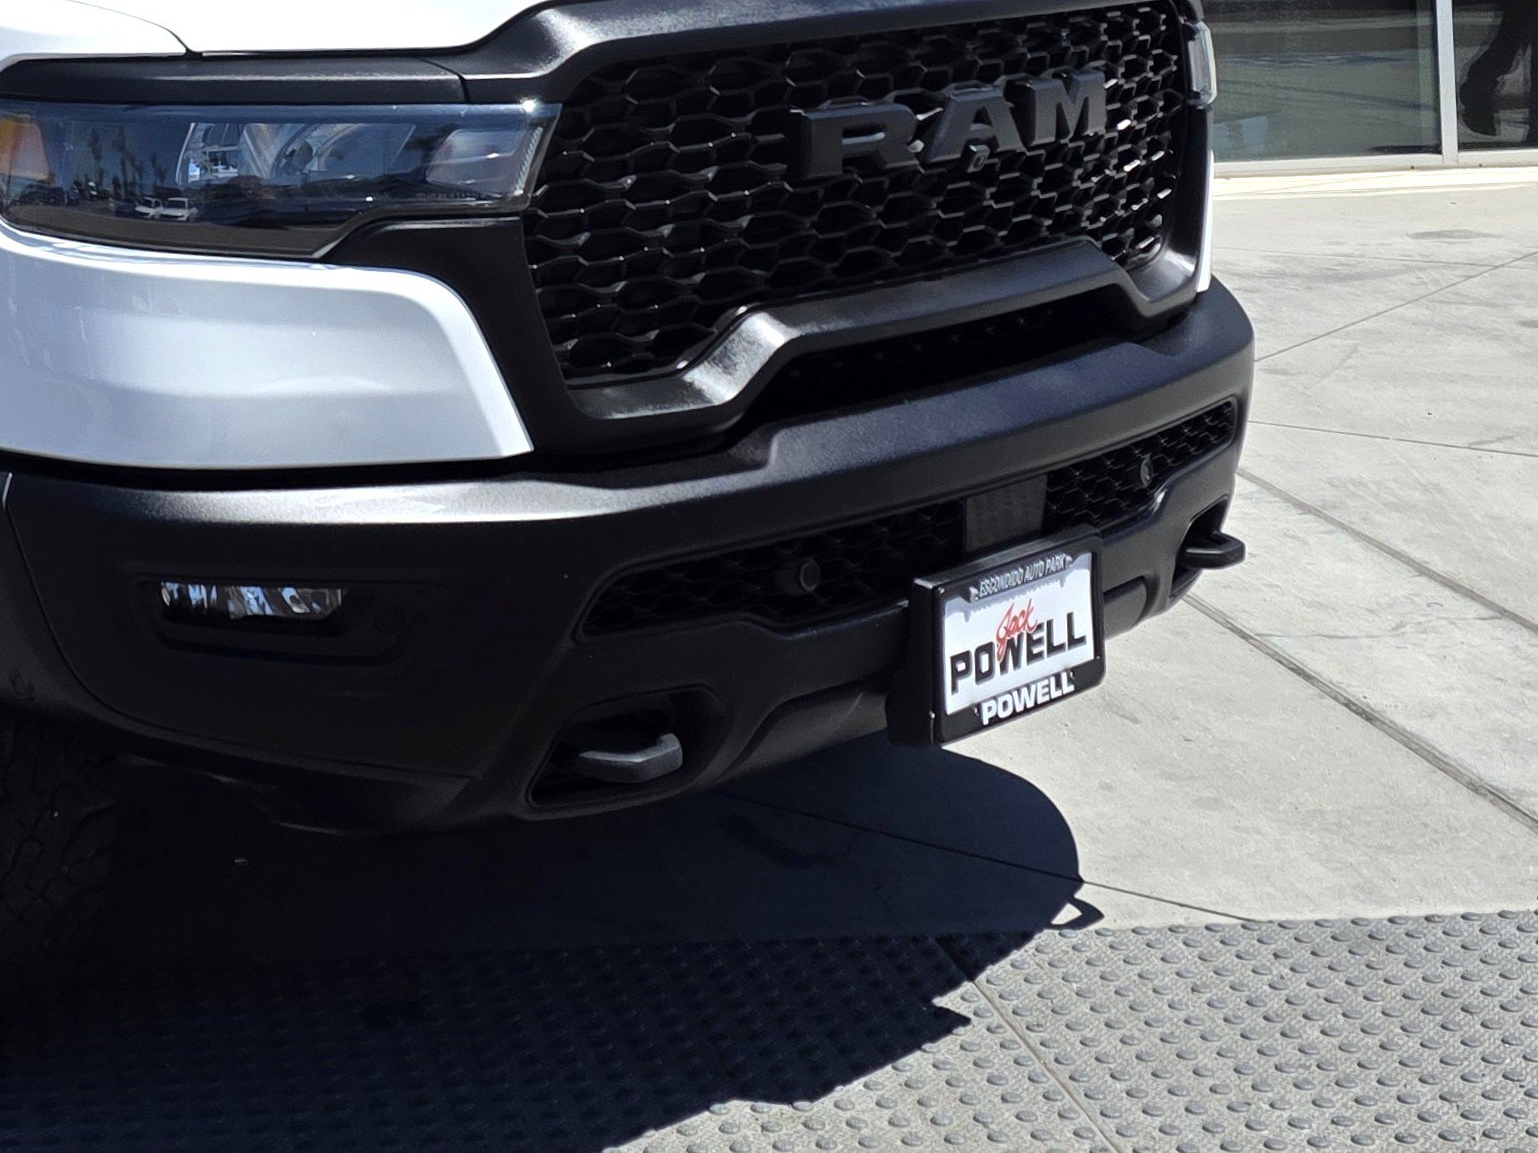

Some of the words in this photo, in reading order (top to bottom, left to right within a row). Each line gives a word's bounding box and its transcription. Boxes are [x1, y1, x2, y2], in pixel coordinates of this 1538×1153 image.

[802, 68, 1108, 178] RAM
[1024, 560, 1045, 583] AUTO
[1044, 552, 1067, 576] PARK
[949, 611, 1087, 696] POWELL
[996, 598, 1039, 663] Jack
[980, 669, 1076, 726] POWELL
